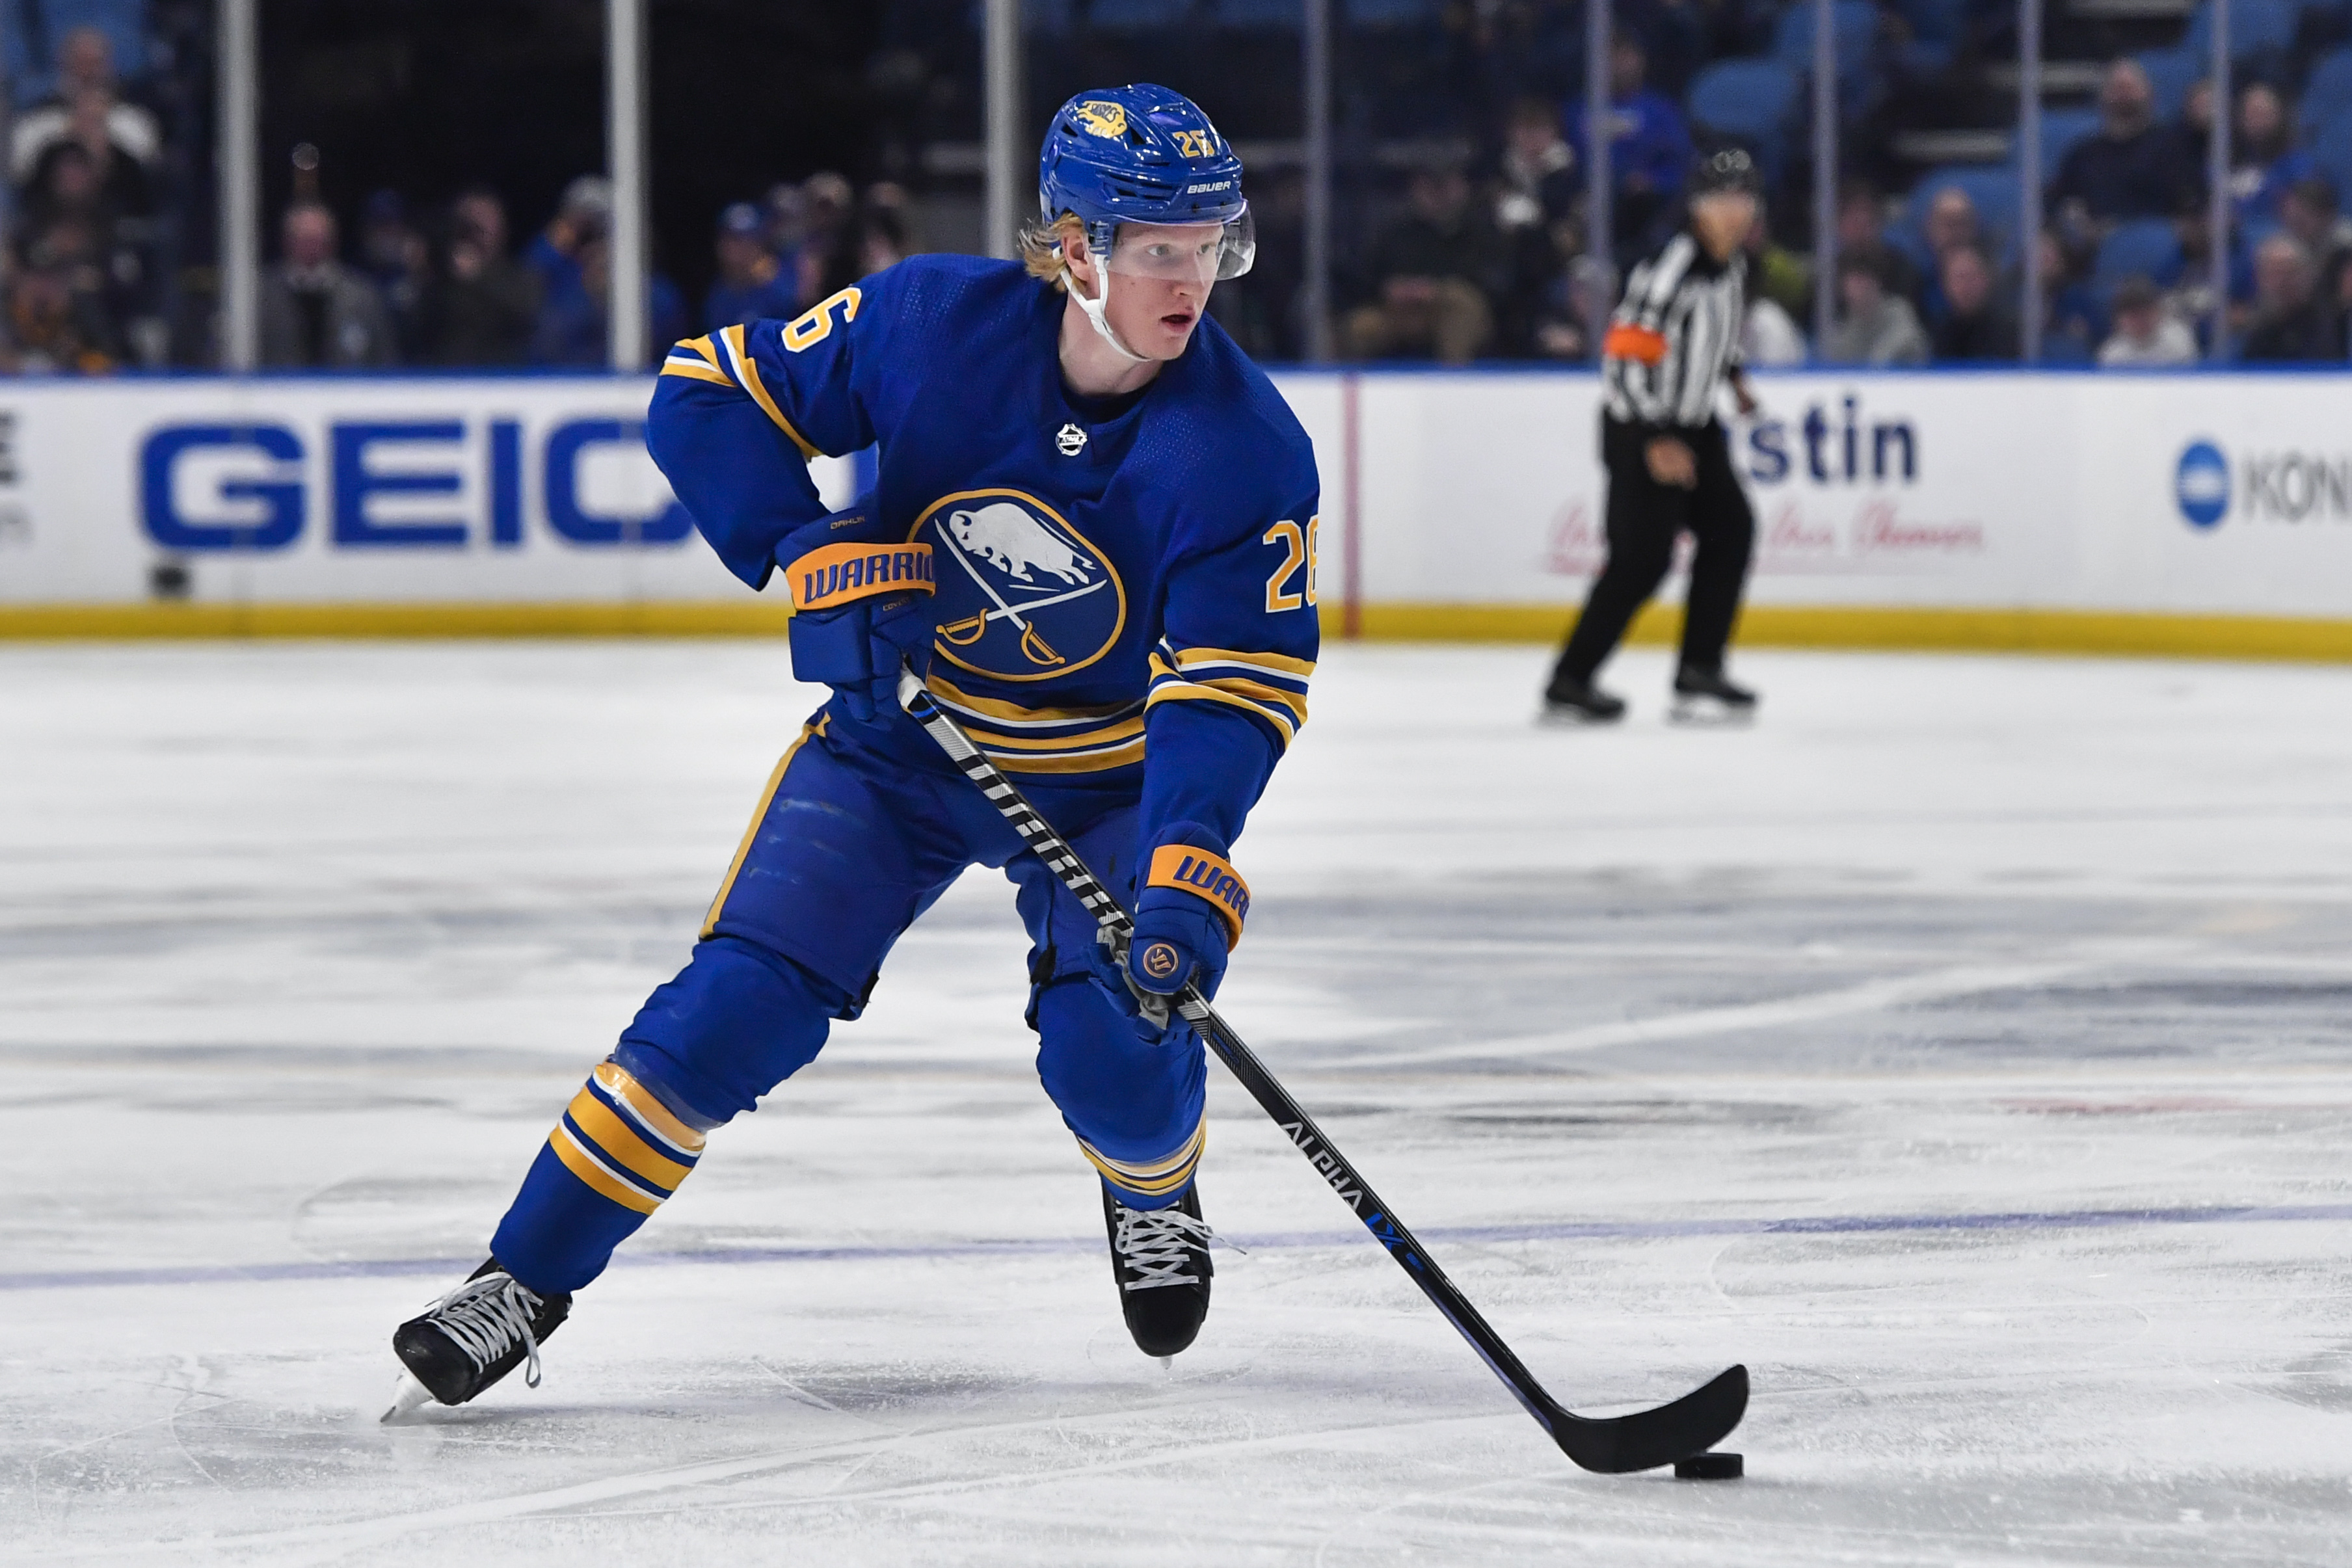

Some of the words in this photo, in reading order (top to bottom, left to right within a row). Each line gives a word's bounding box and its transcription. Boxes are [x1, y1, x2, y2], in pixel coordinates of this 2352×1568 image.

[1172, 129, 1215, 158] 26
[1187, 180, 1231, 194] BAUER
[1279, 1121, 1363, 1212] ALPHA
[1365, 1212, 1405, 1252] LX
